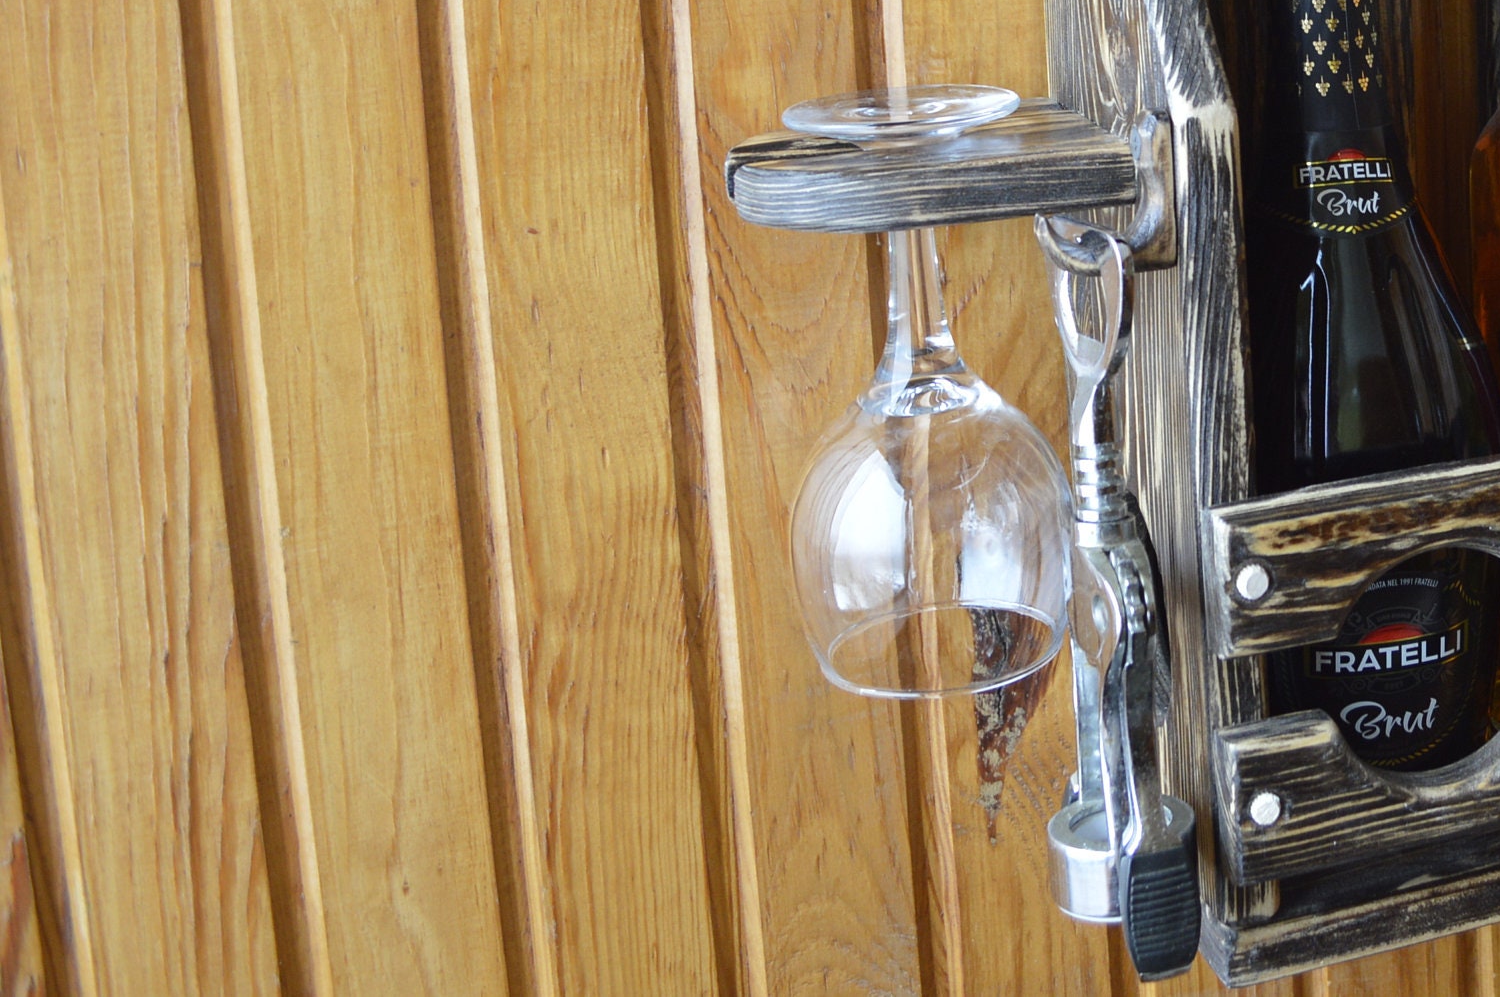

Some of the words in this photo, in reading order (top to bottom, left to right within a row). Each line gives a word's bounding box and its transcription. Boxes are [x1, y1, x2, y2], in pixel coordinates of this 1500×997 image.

[1299, 162, 1392, 184] FRATELLI
[1316, 188, 1380, 217] Brut
[1387, 578, 1398, 588] NEL
[1400, 578, 1413, 586] 1991
[1414, 577, 1440, 588] FRATELLI
[1315, 629, 1461, 674] FRATELLI
[1340, 697, 1440, 740] Brut
